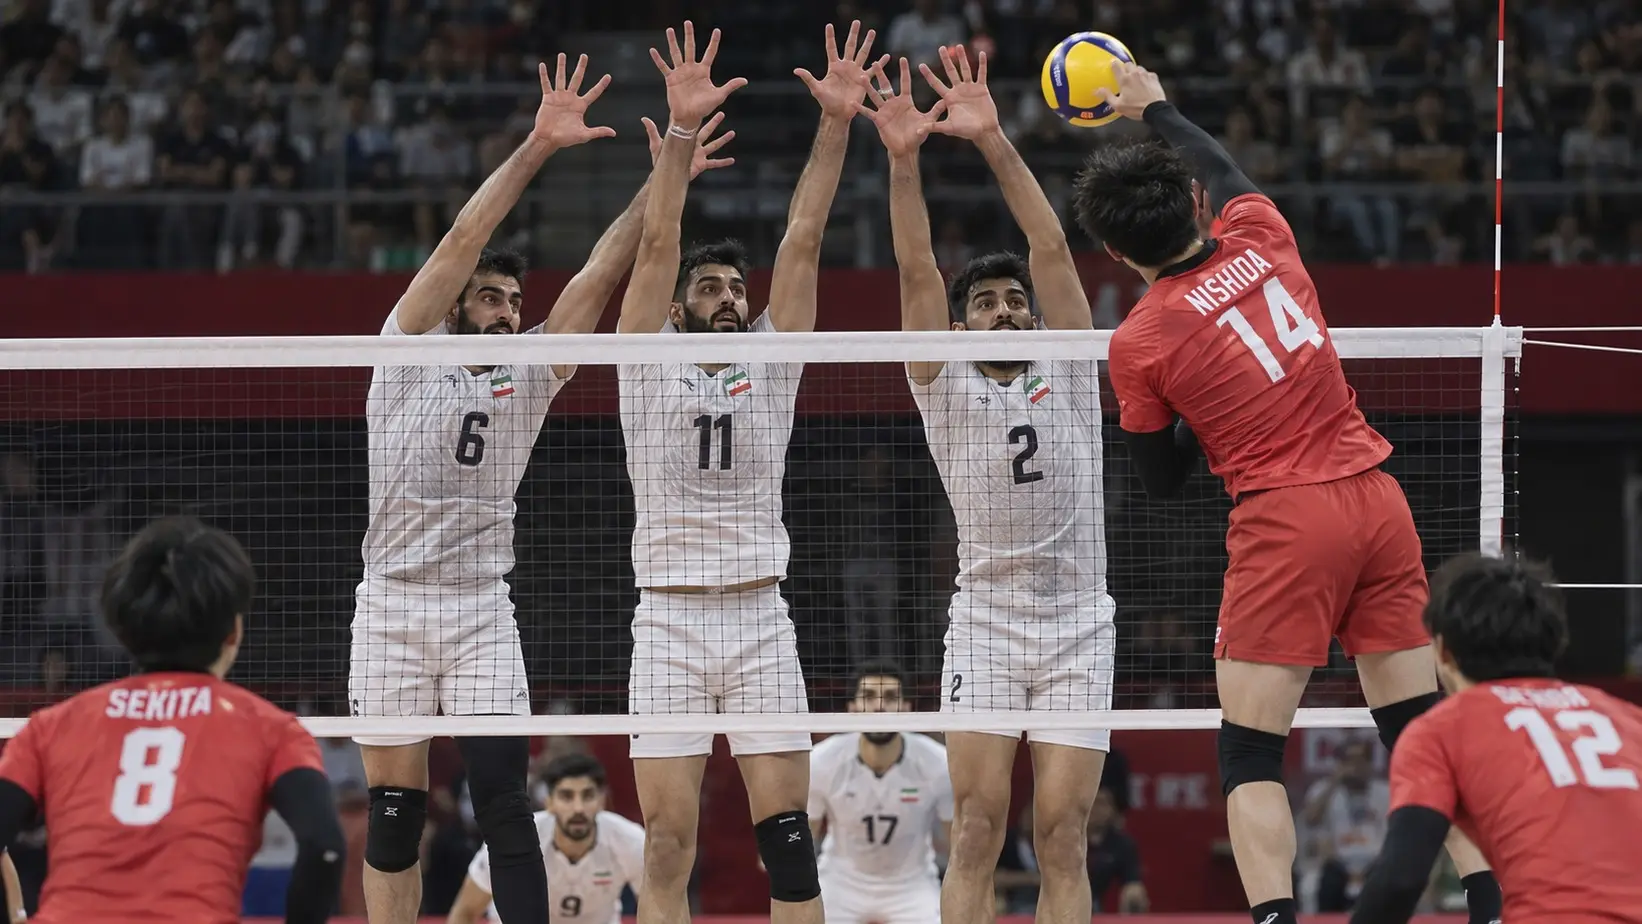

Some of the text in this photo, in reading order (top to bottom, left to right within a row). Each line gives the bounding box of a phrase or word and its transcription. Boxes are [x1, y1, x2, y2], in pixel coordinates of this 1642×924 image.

[1184, 248, 1273, 317] NISHIDA
[1215, 275, 1325, 383] 14
[455, 411, 490, 467] 6
[693, 413, 732, 470] 11
[1008, 424, 1044, 485] 2
[105, 686, 212, 720] SEKITA
[950, 673, 963, 702] 2
[110, 726, 187, 826] 8
[1503, 706, 1640, 790] 12
[861, 814, 898, 846] 17
[560, 894, 583, 919] 9
